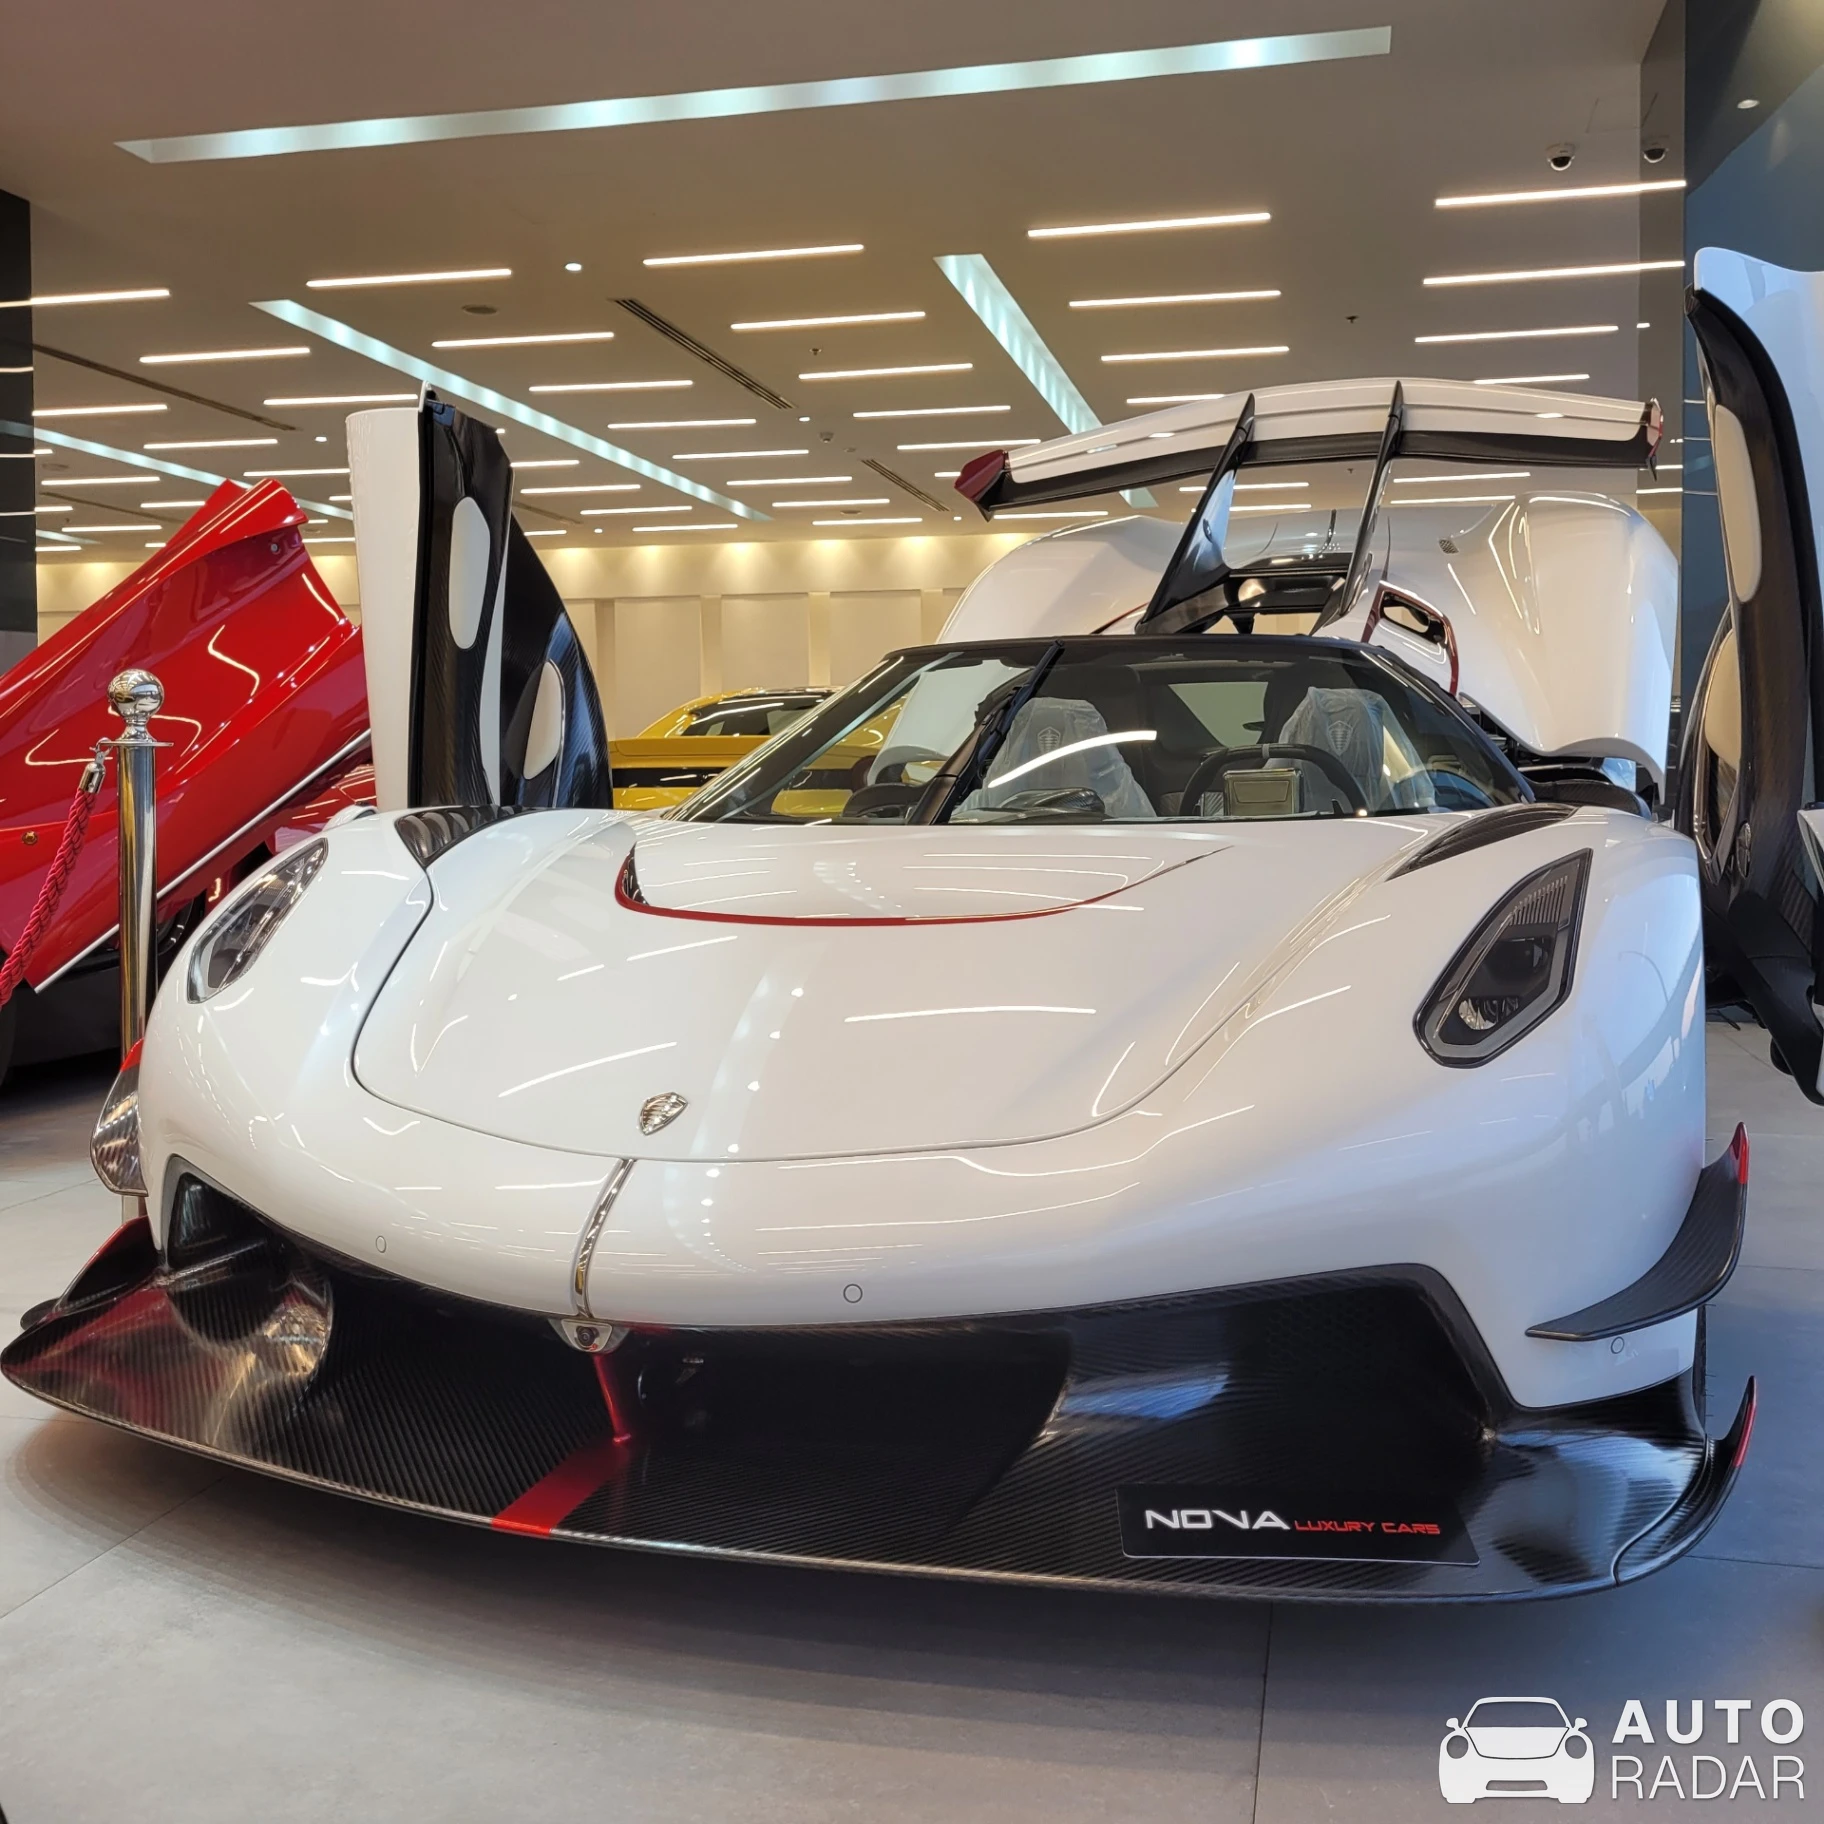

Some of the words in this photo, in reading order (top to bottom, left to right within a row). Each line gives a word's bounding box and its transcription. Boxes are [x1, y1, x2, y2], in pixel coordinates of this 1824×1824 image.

[1145, 1509, 1291, 1530] NOVA
[1294, 1520, 1375, 1532] LUXURY
[1381, 1522, 1440, 1535] CARS
